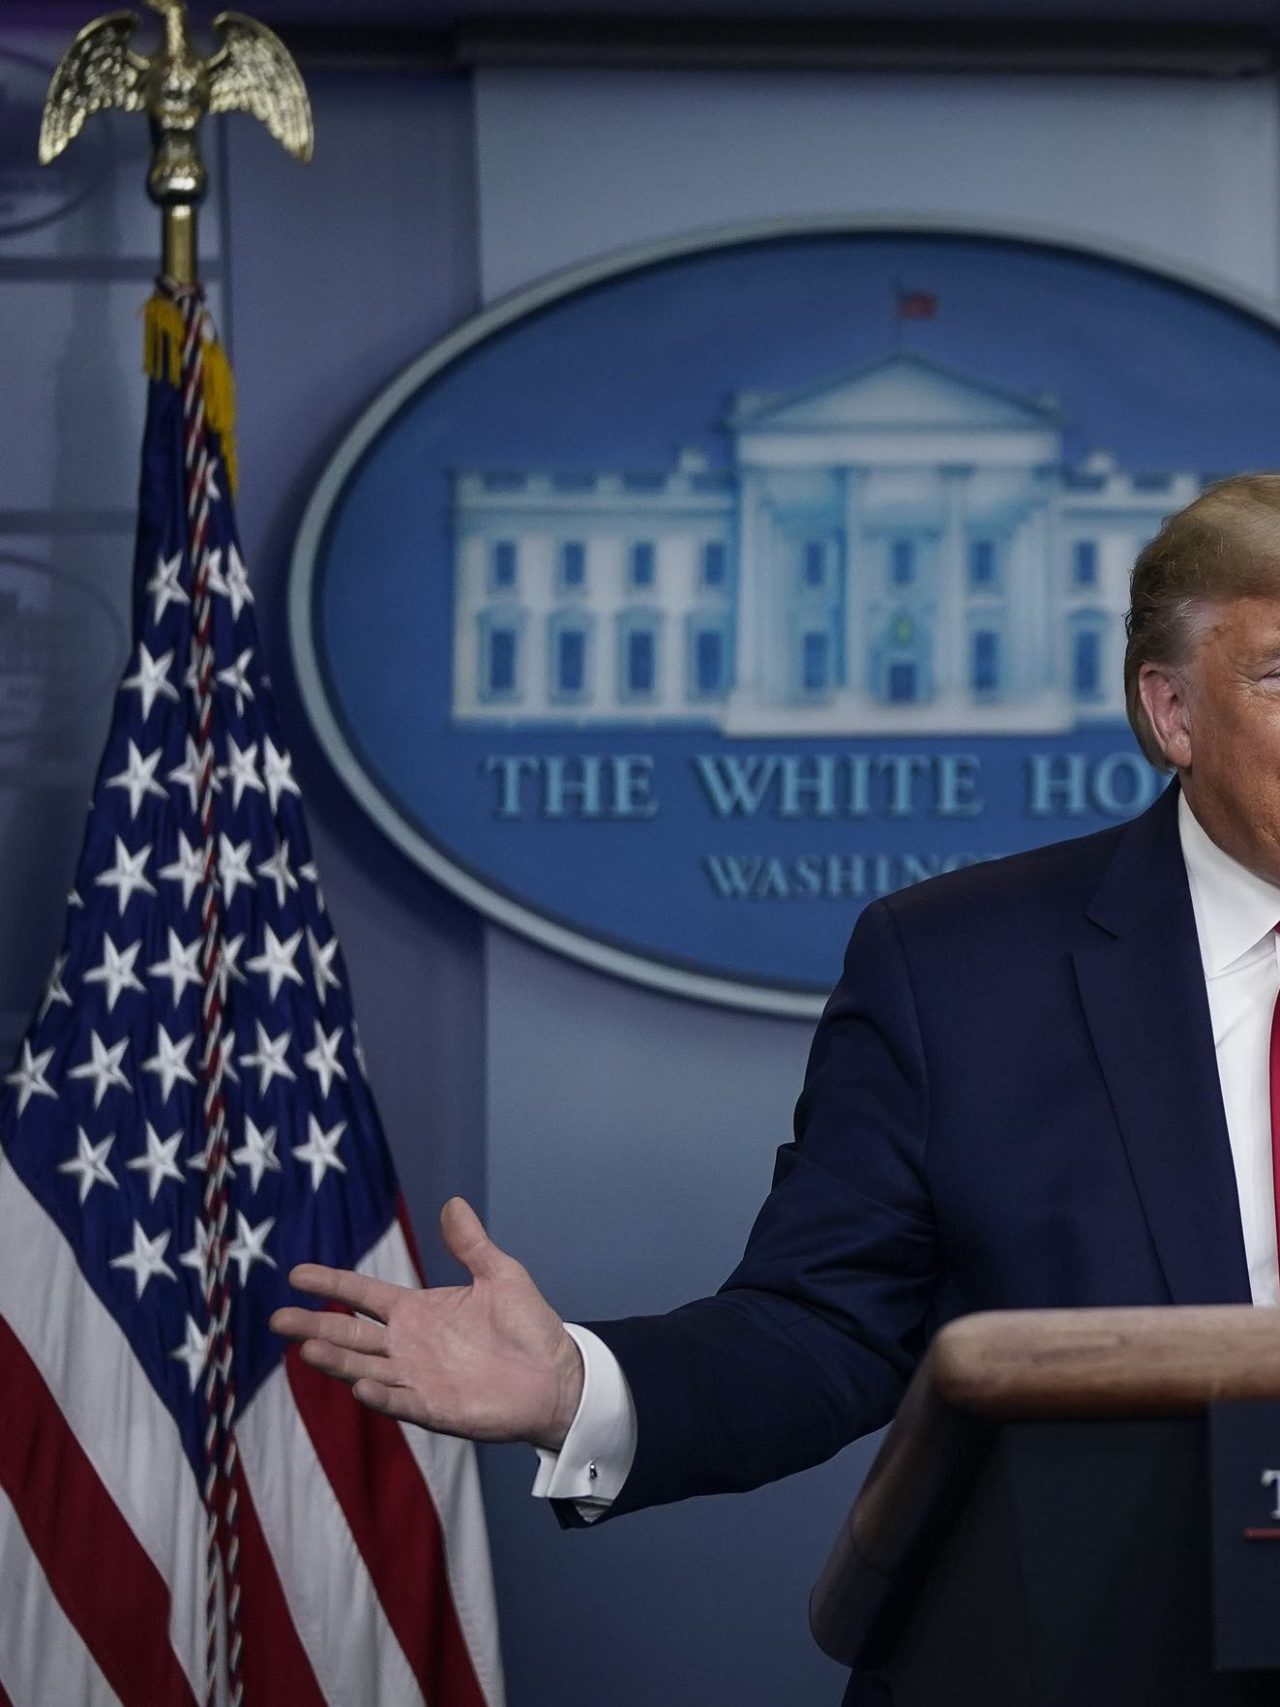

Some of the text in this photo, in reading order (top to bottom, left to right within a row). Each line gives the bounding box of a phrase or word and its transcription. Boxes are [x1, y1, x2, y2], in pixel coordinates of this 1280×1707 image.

[484, 752, 1176, 817] THE WHITE HO
